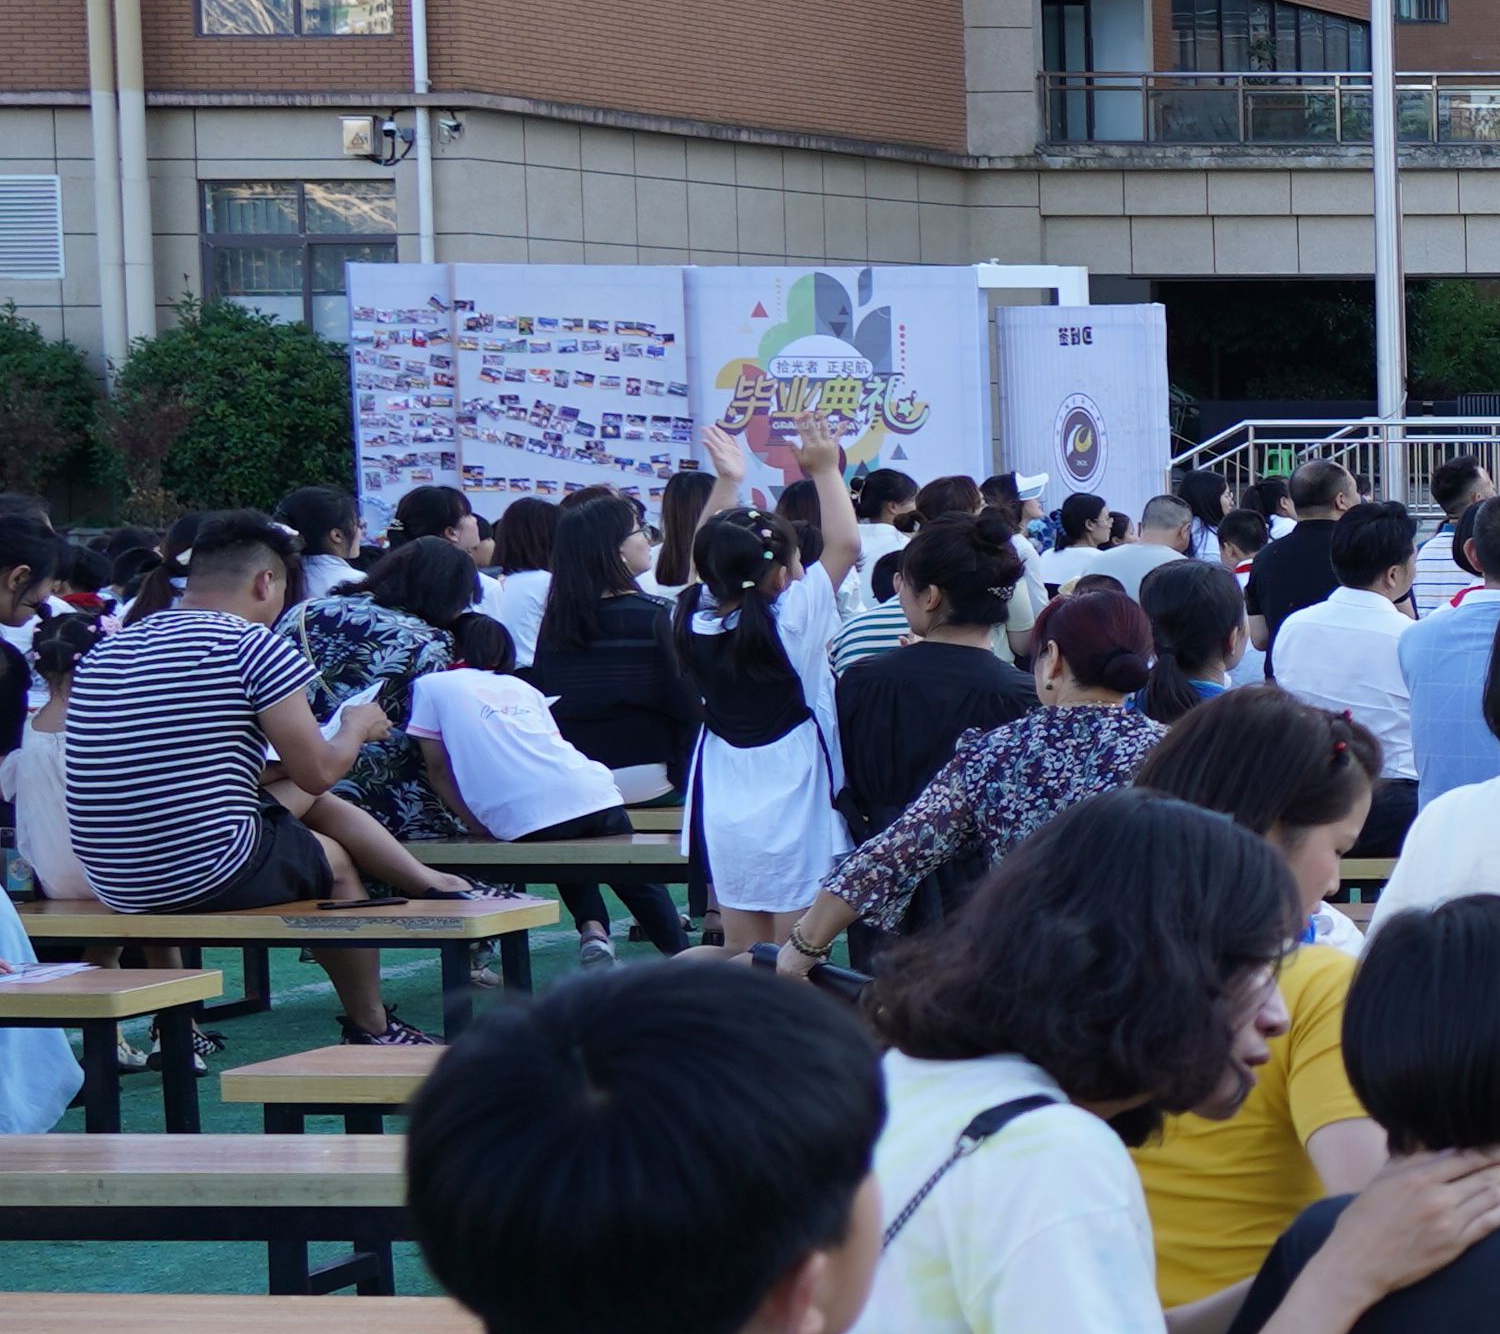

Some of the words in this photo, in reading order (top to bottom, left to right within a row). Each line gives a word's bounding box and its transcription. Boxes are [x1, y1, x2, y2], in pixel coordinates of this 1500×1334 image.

[776, 360, 818, 374] 拾光者
[826, 361, 869, 374] 正起航
[716, 374, 930, 429] 毕业典礼
